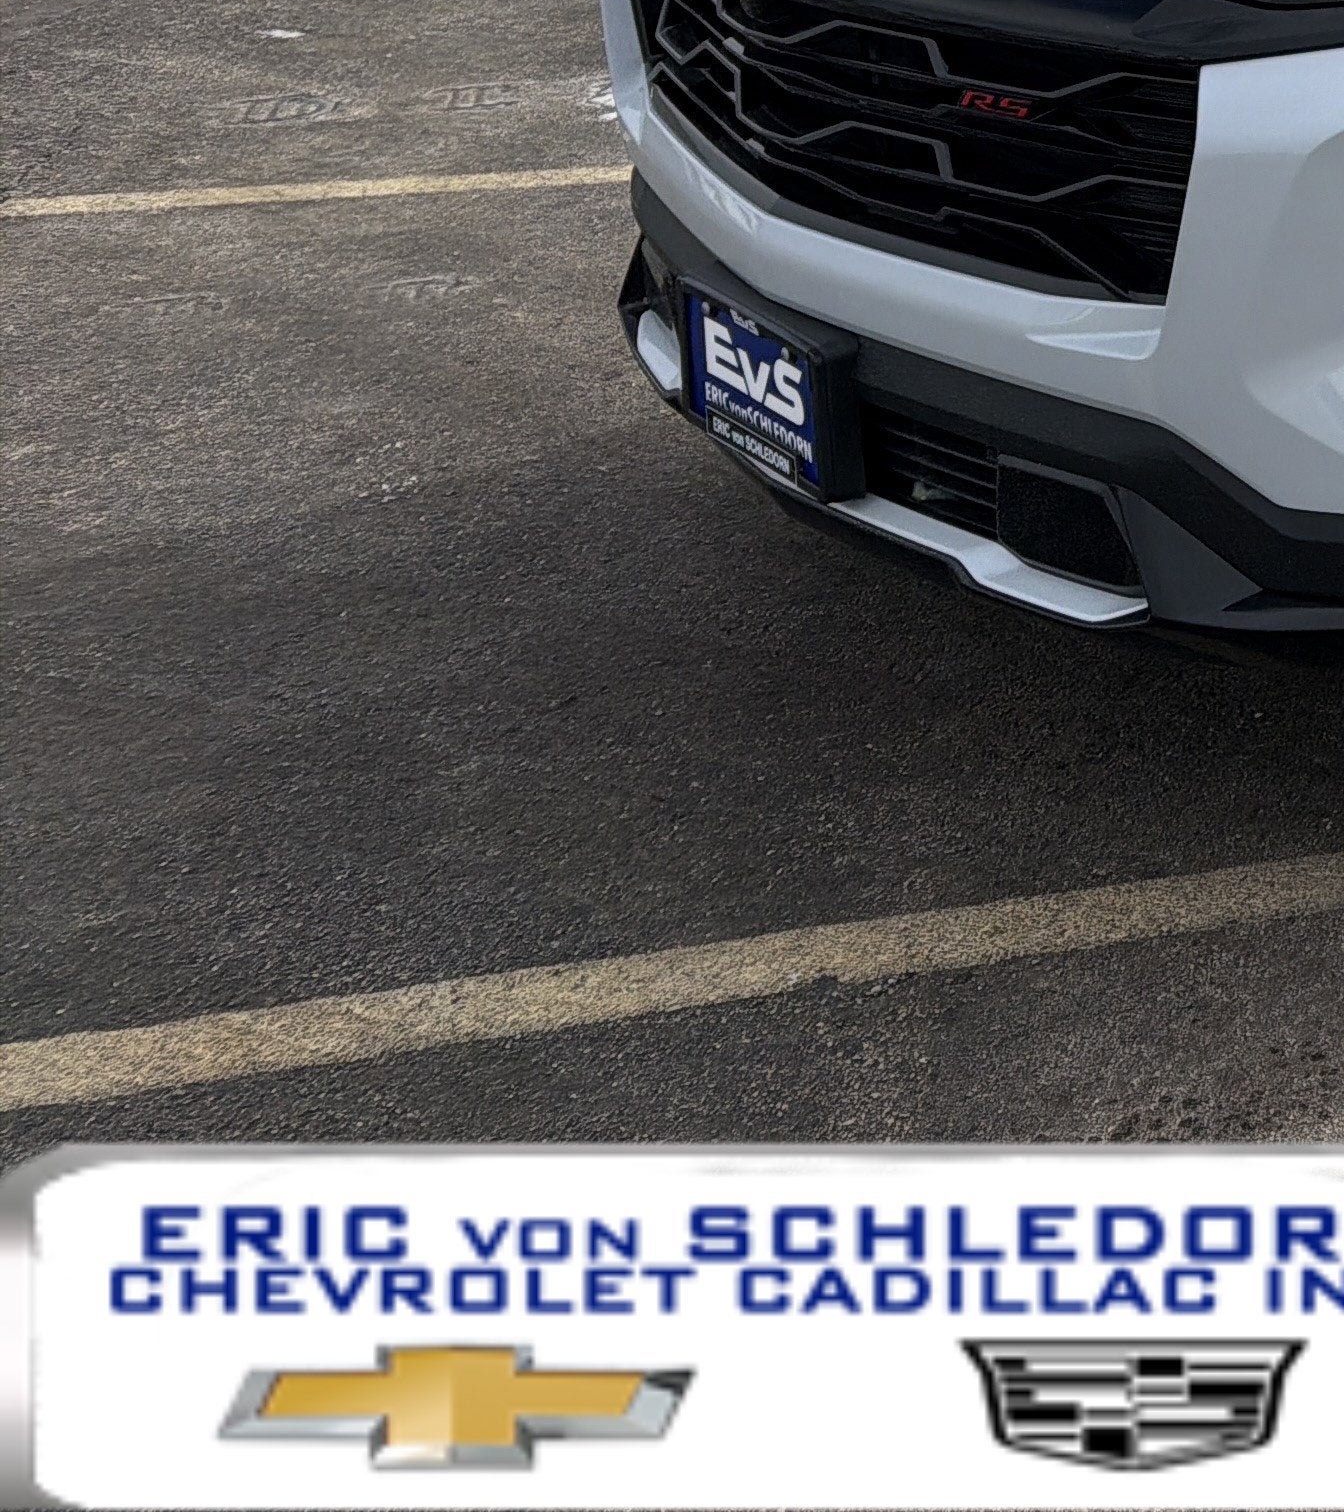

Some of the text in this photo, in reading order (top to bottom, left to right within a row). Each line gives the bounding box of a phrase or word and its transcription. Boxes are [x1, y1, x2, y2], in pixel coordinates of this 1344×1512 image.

[961, 89, 1032, 118] RS
[704, 381, 730, 411] ERIC
[712, 415, 731, 439] ERIC
[745, 435, 790, 475] SCHLEDORN
